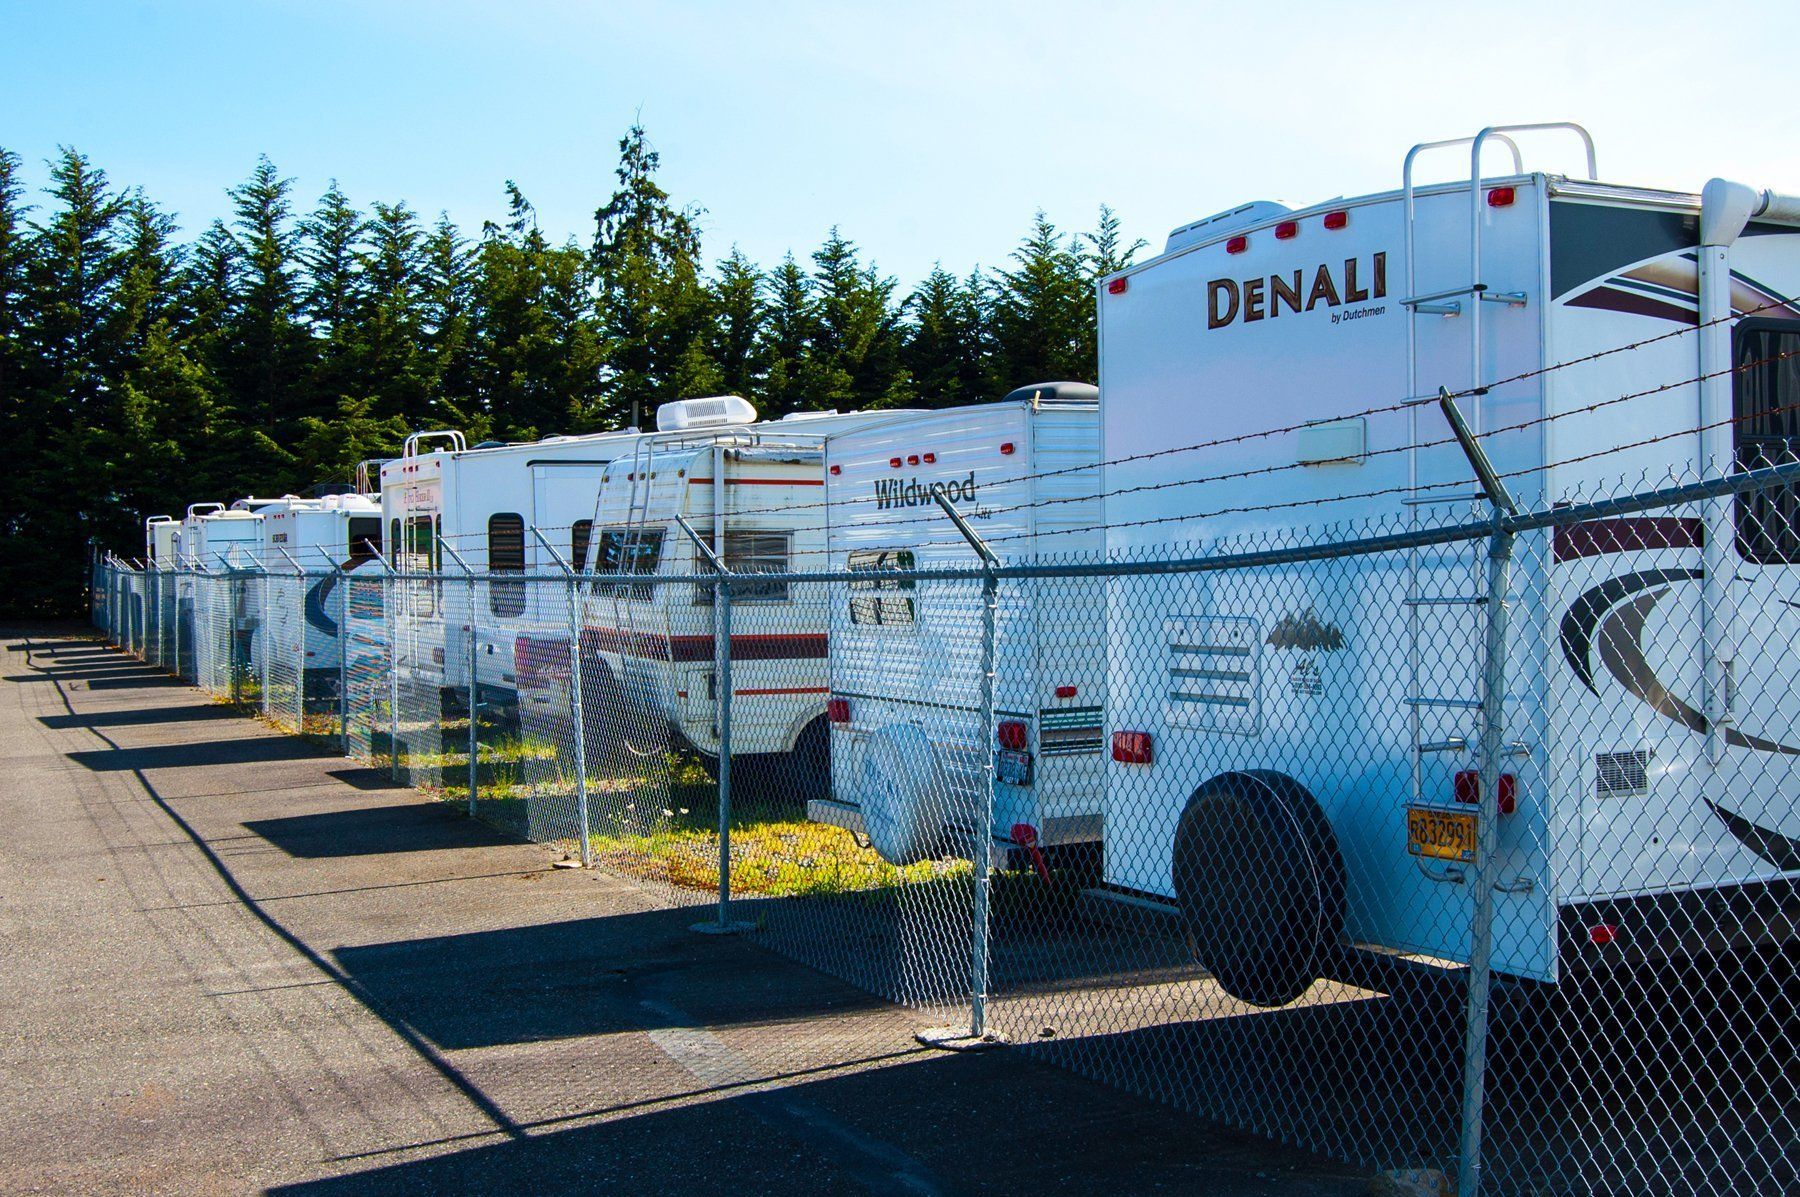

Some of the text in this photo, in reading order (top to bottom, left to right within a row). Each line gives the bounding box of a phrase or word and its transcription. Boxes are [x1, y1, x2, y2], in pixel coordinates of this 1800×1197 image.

[1207, 251, 1387, 331] DENALI
[1331, 304, 1386, 325] by Dutchmen
[874, 470, 976, 510] Wildwood
